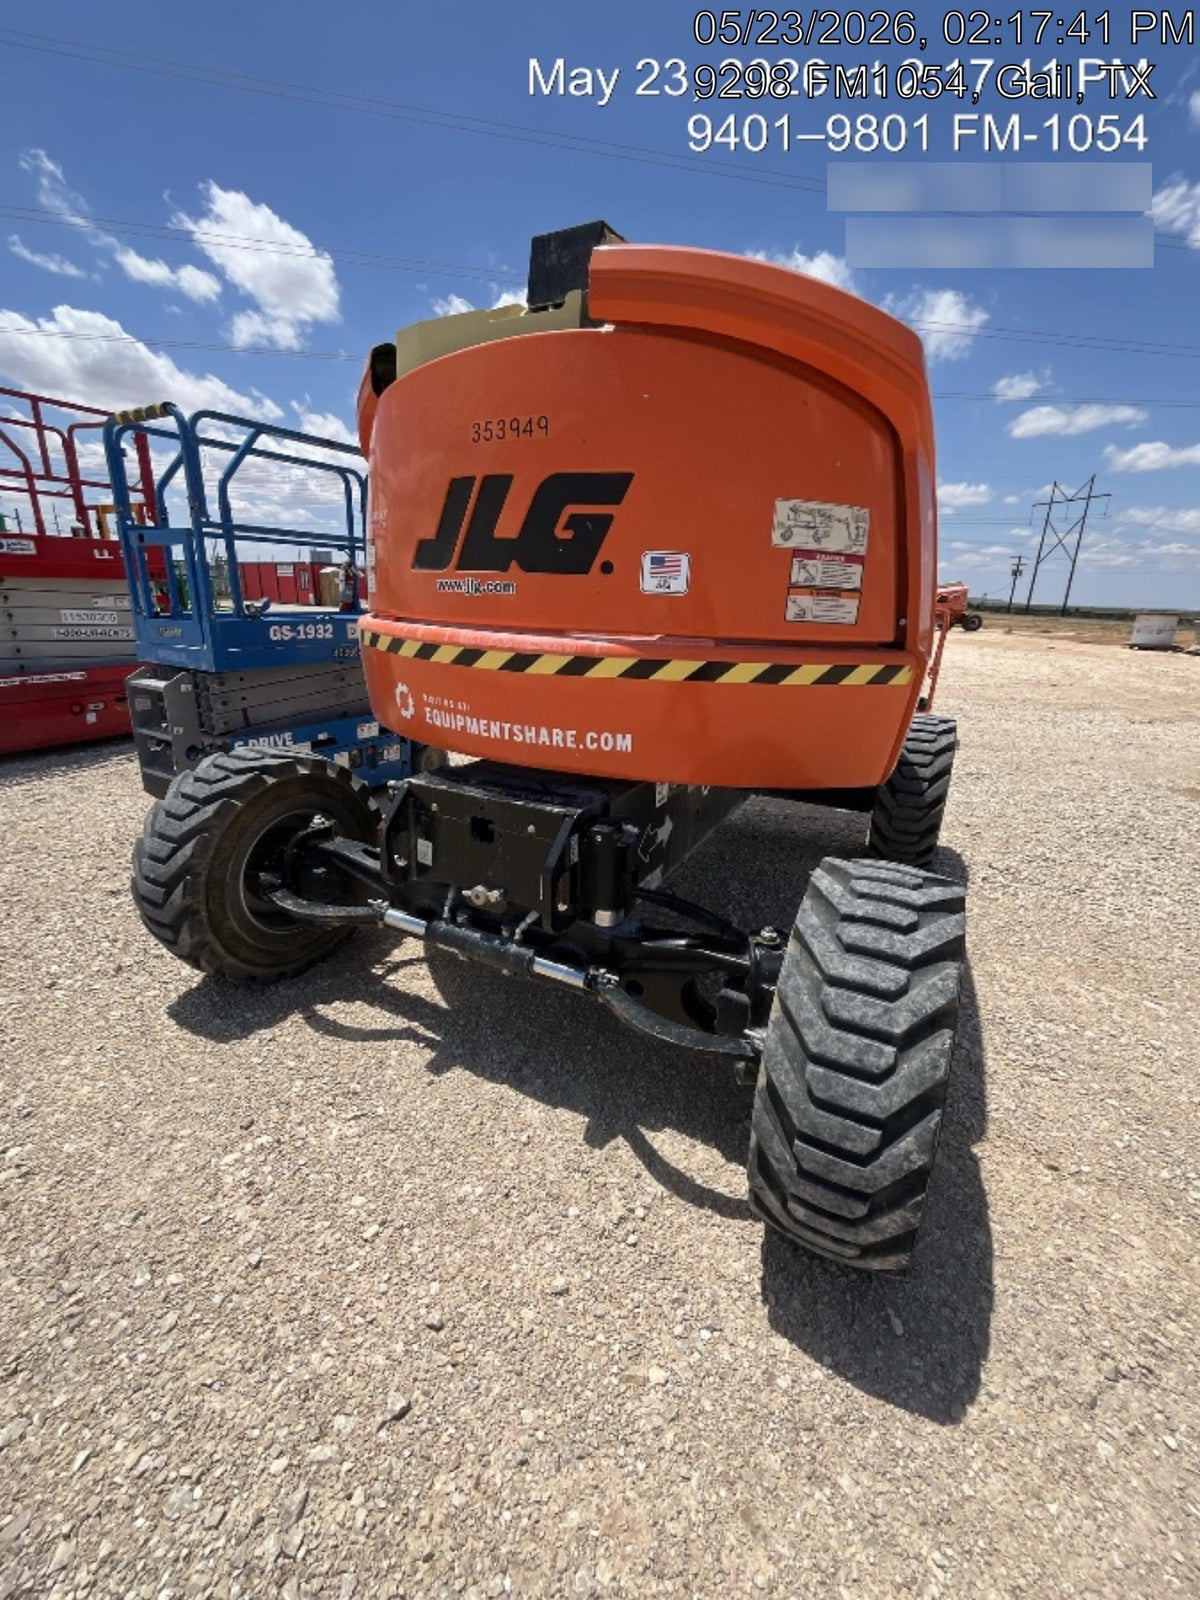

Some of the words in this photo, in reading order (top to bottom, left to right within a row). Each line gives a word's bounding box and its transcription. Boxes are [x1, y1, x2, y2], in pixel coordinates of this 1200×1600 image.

[472, 415, 549, 444] 353949
[436, 576, 517, 597] www.jlg.com
[269, 622, 334, 641] GS-1932
[424, 706, 633, 753] EQUIPMENTSHARE.COM
